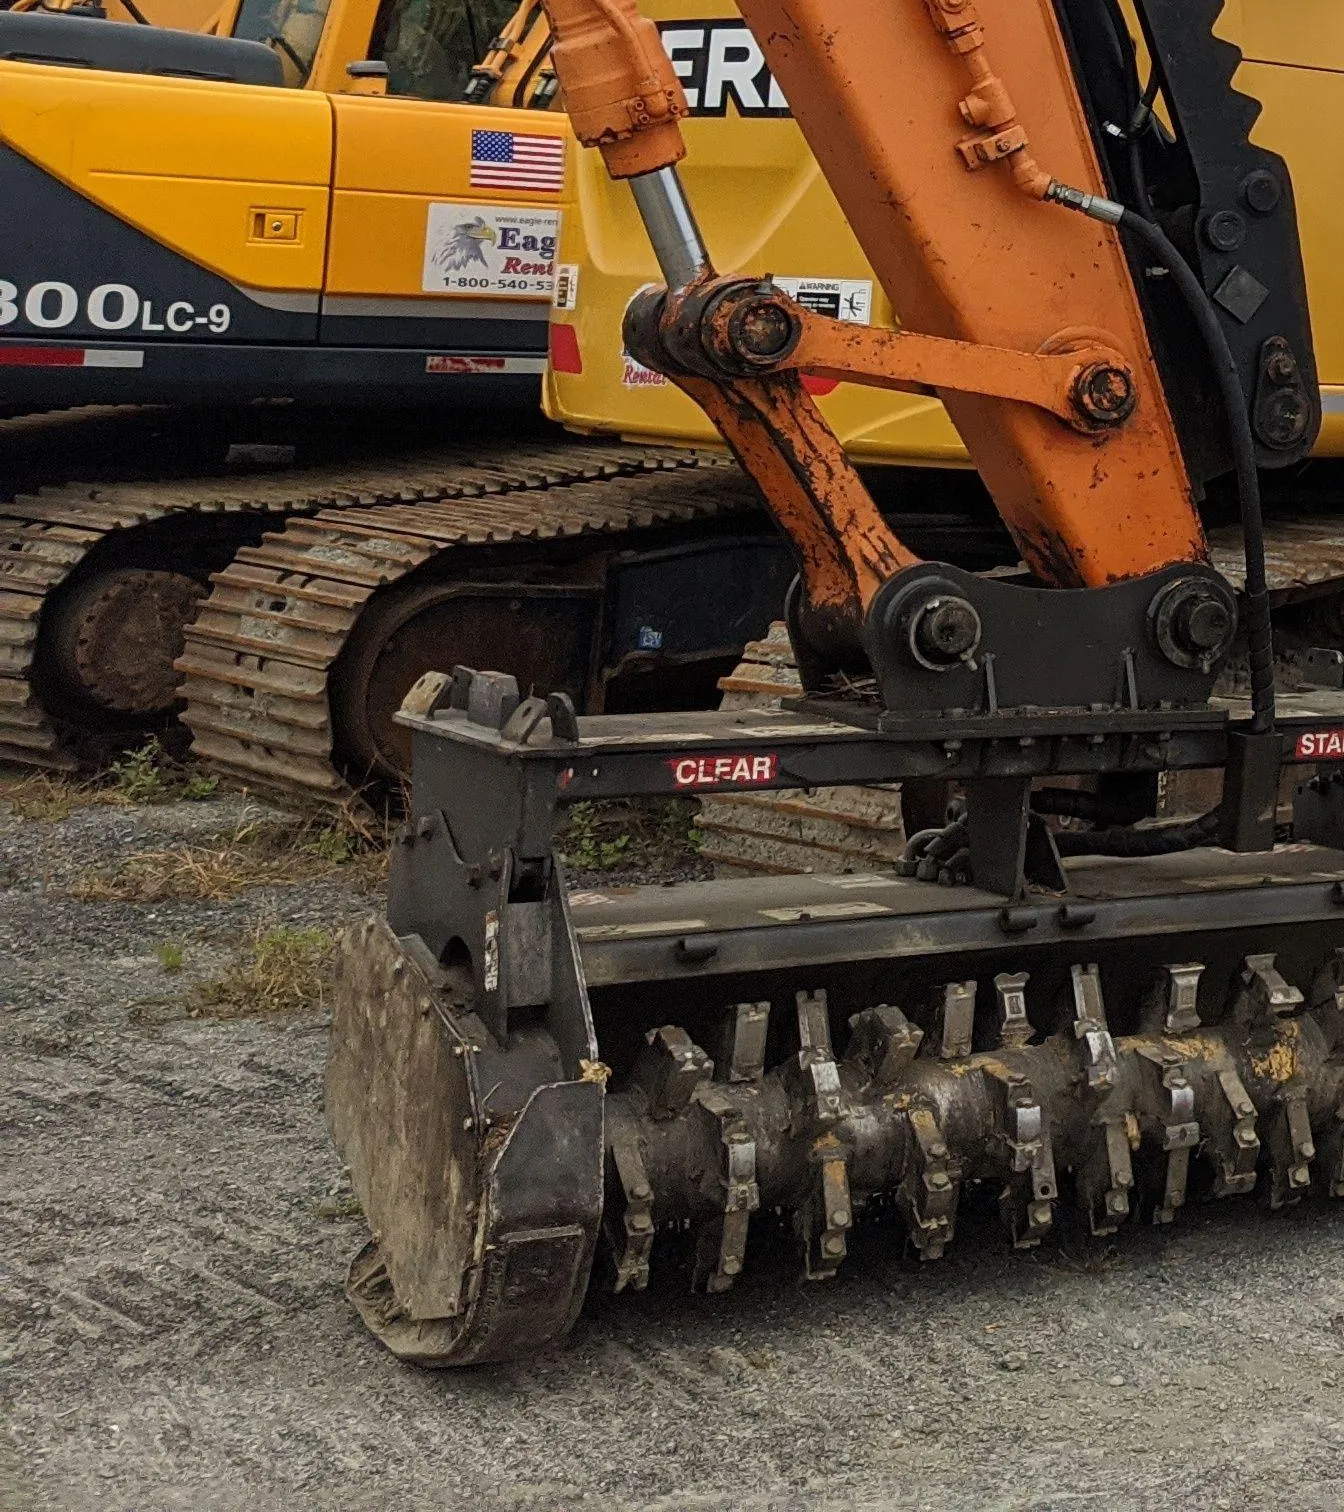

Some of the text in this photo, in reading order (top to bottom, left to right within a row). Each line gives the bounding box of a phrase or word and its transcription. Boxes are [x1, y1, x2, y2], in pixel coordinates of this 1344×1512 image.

[495, 215, 558, 226] www.eagle-ren
[497, 227, 556, 260] Eag
[443, 277, 553, 291] 1-800-540-53
[675, 755, 771, 784] CLEAR
